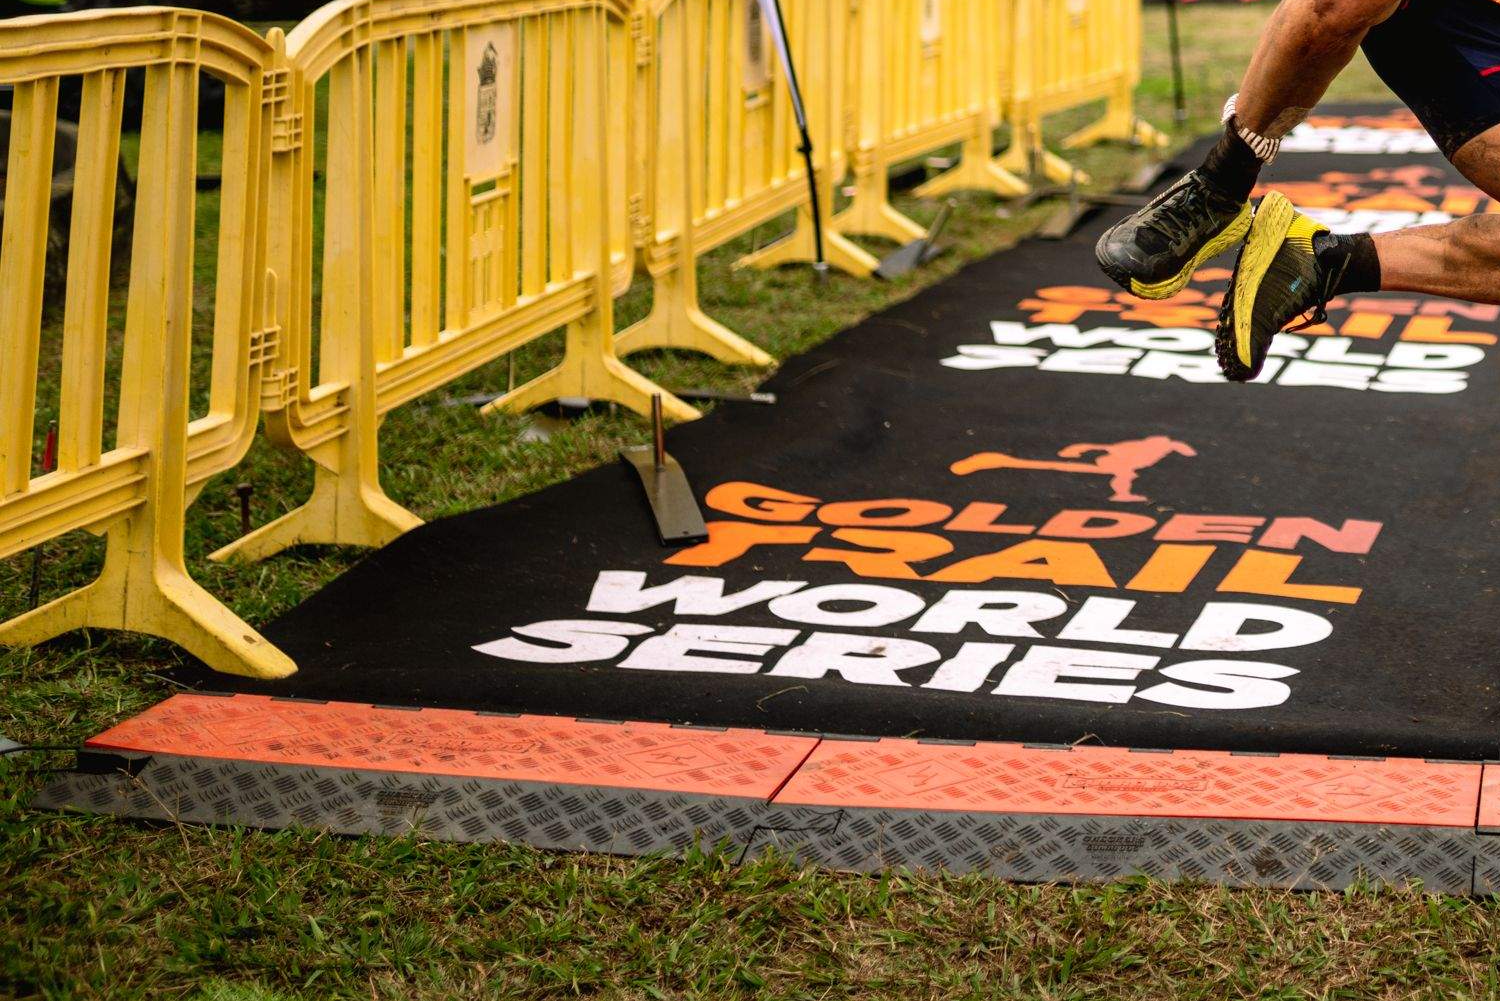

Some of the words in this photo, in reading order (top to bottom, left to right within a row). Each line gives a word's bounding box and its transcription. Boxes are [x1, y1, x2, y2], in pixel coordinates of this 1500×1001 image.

[705, 481, 1383, 554] GOLDEN
[662, 520, 1362, 604] TRAIL
[586, 570, 1333, 651] WORLD
[470, 618, 1300, 709] SERIES
